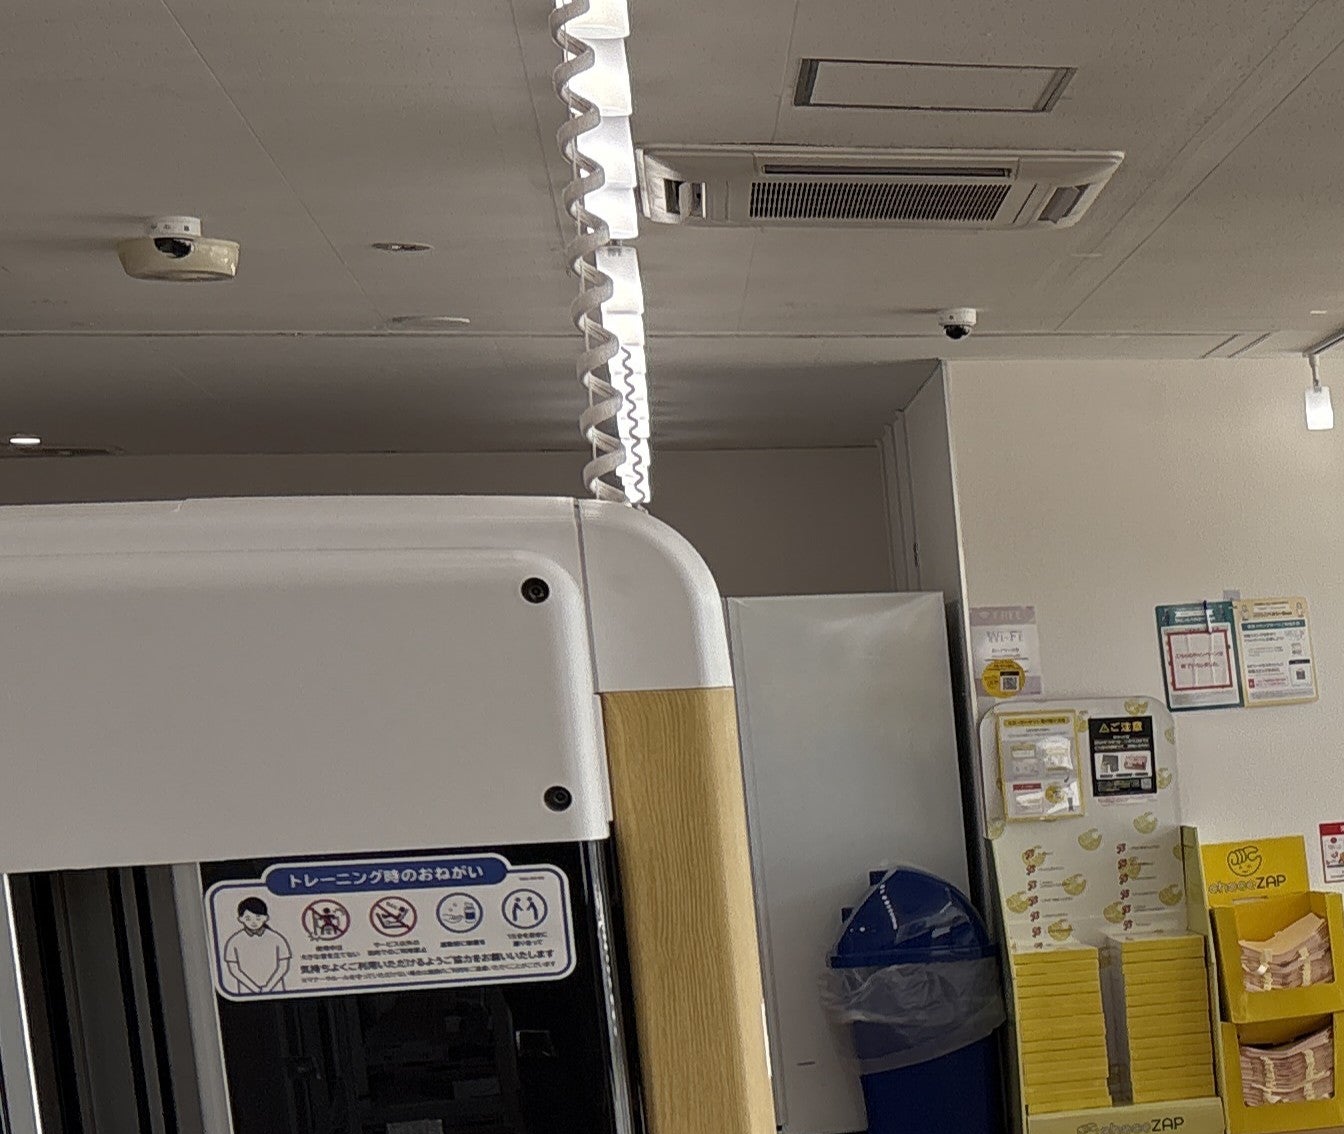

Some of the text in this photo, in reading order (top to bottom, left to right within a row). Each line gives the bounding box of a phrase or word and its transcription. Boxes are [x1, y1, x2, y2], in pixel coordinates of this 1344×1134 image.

[987, 631, 1023, 643] Wi-Fi
[289, 865, 484, 889] トレーニング時のおねがい
